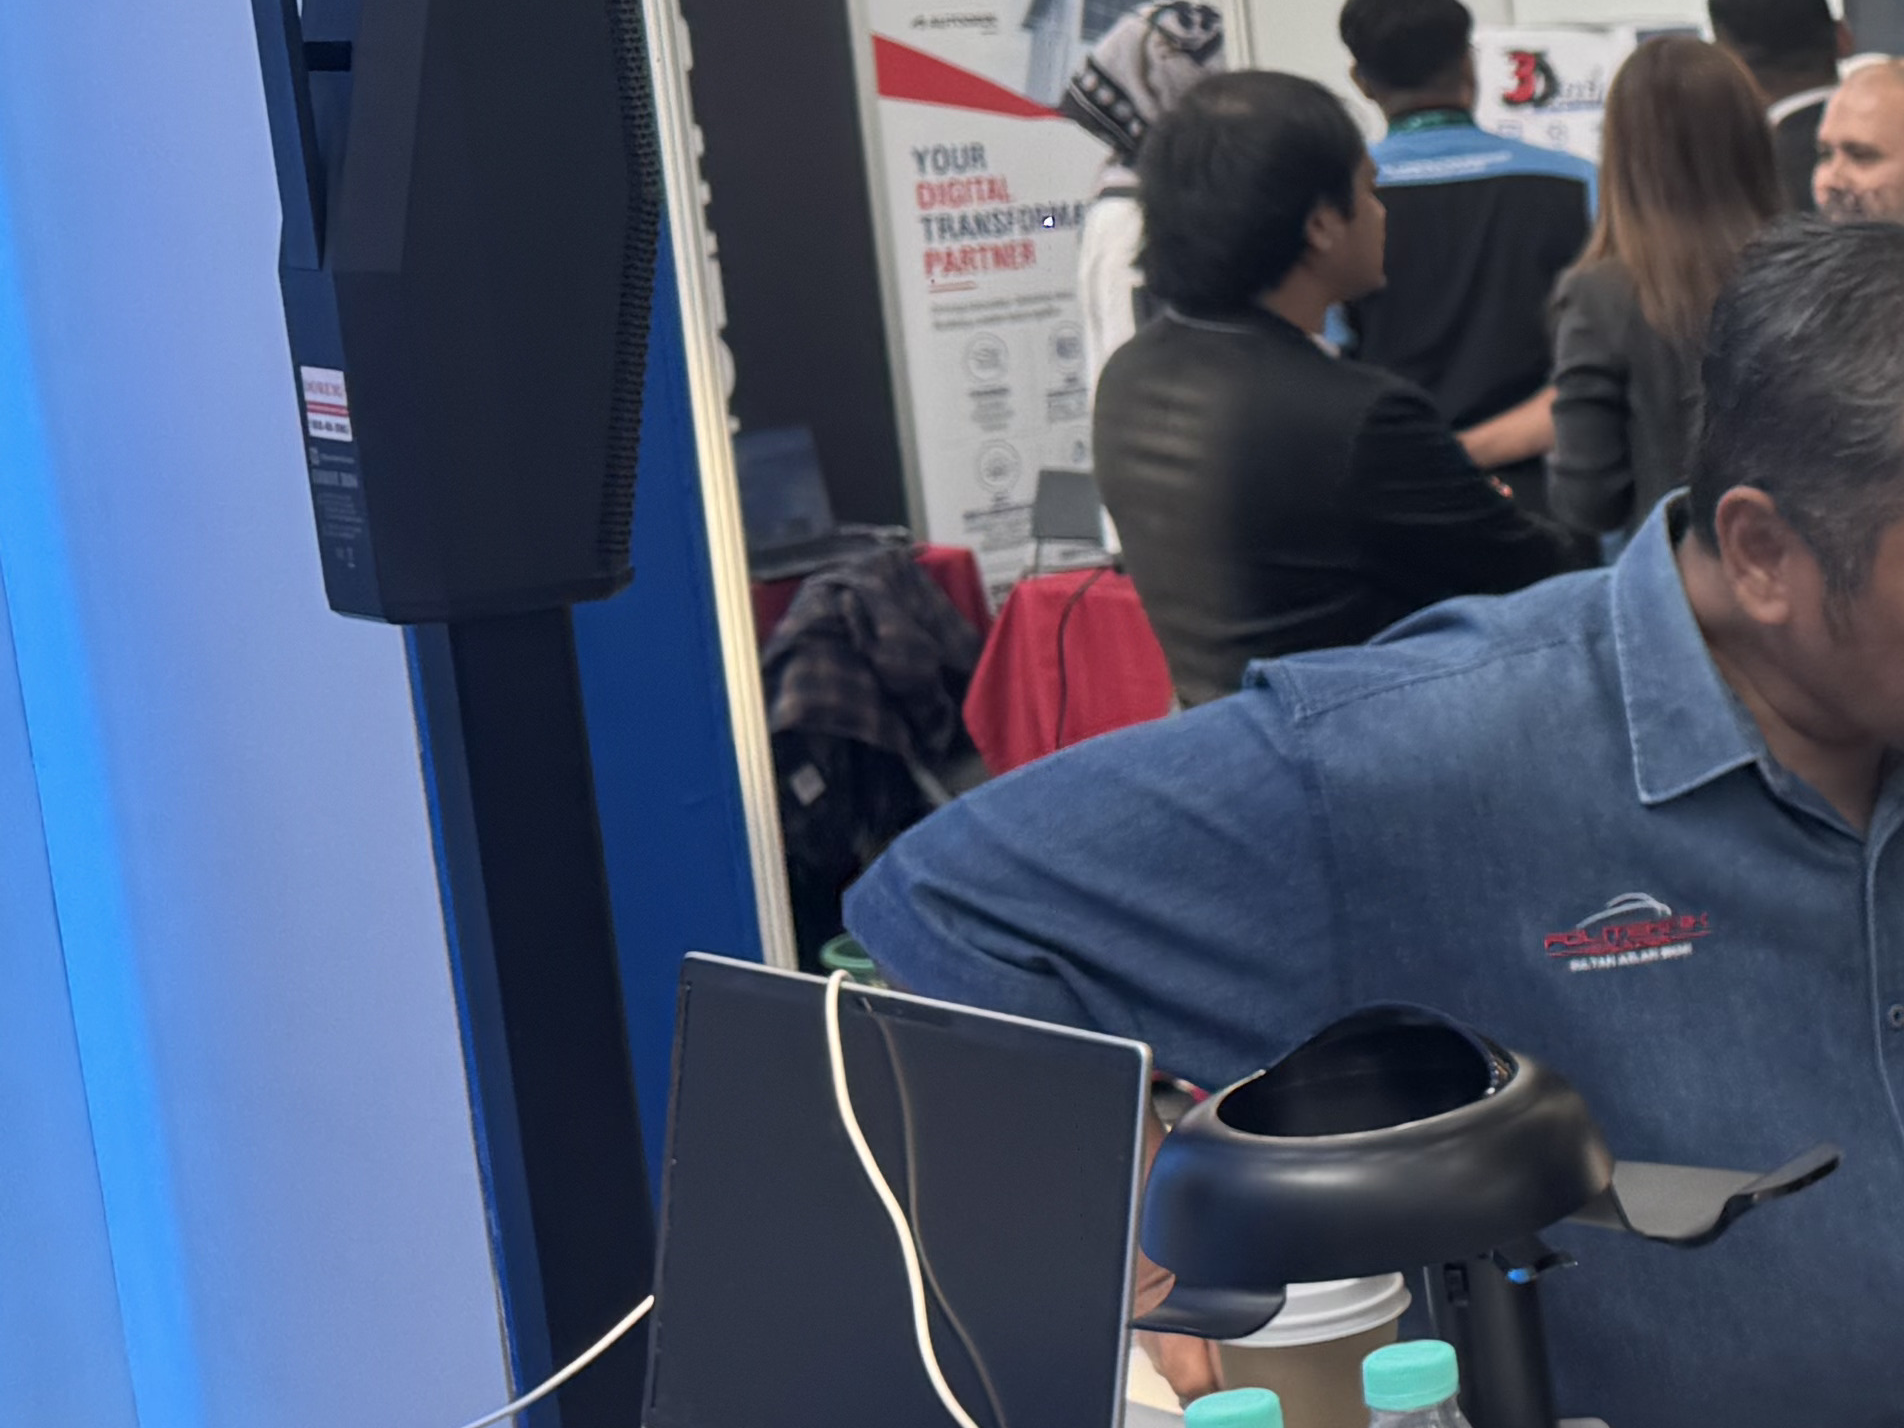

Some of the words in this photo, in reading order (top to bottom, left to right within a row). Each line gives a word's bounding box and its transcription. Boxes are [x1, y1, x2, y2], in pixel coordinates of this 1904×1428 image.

[912, 140, 988, 176] YOUR
[915, 174, 1012, 211] DIGITAL
[920, 199, 1086, 243] TRANSFORMA
[923, 237, 1037, 279] PARTNER
